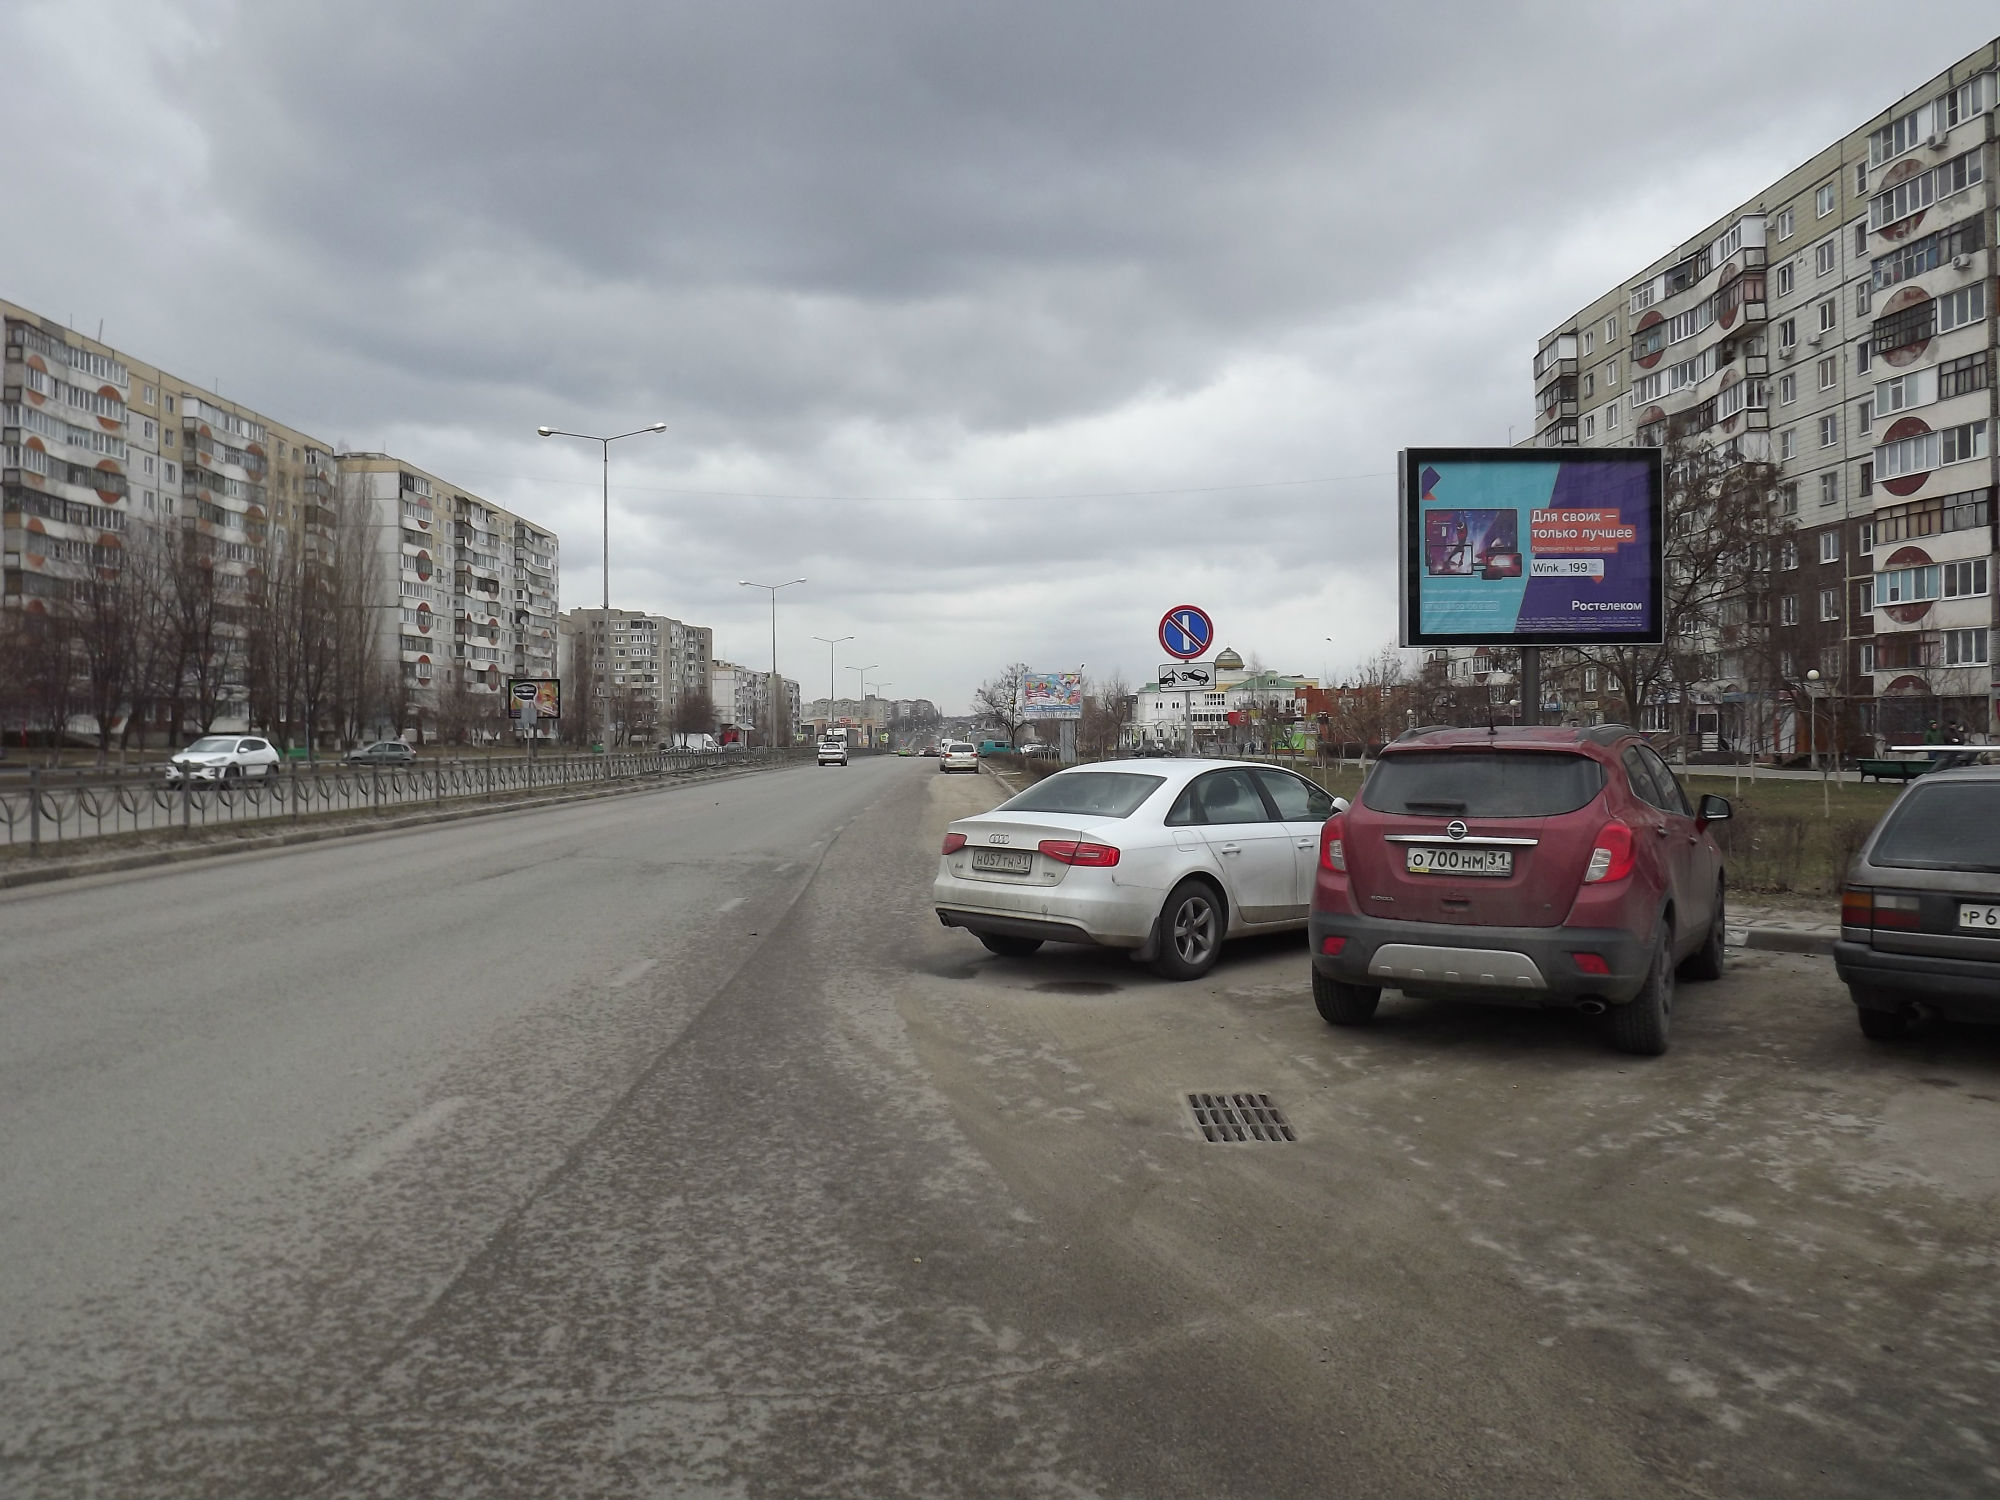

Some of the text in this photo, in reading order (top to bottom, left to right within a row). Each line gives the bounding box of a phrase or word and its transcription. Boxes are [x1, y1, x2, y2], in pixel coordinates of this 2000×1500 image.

[1531, 510, 1558, 523] Для
[1561, 512, 1601, 522] своих
[1531, 529, 1633, 541] только лучшее
[1532, 563, 1559, 573] Wink
[1568, 562, 1588, 573] 199
[1571, 600, 1642, 611] Ростелеком
